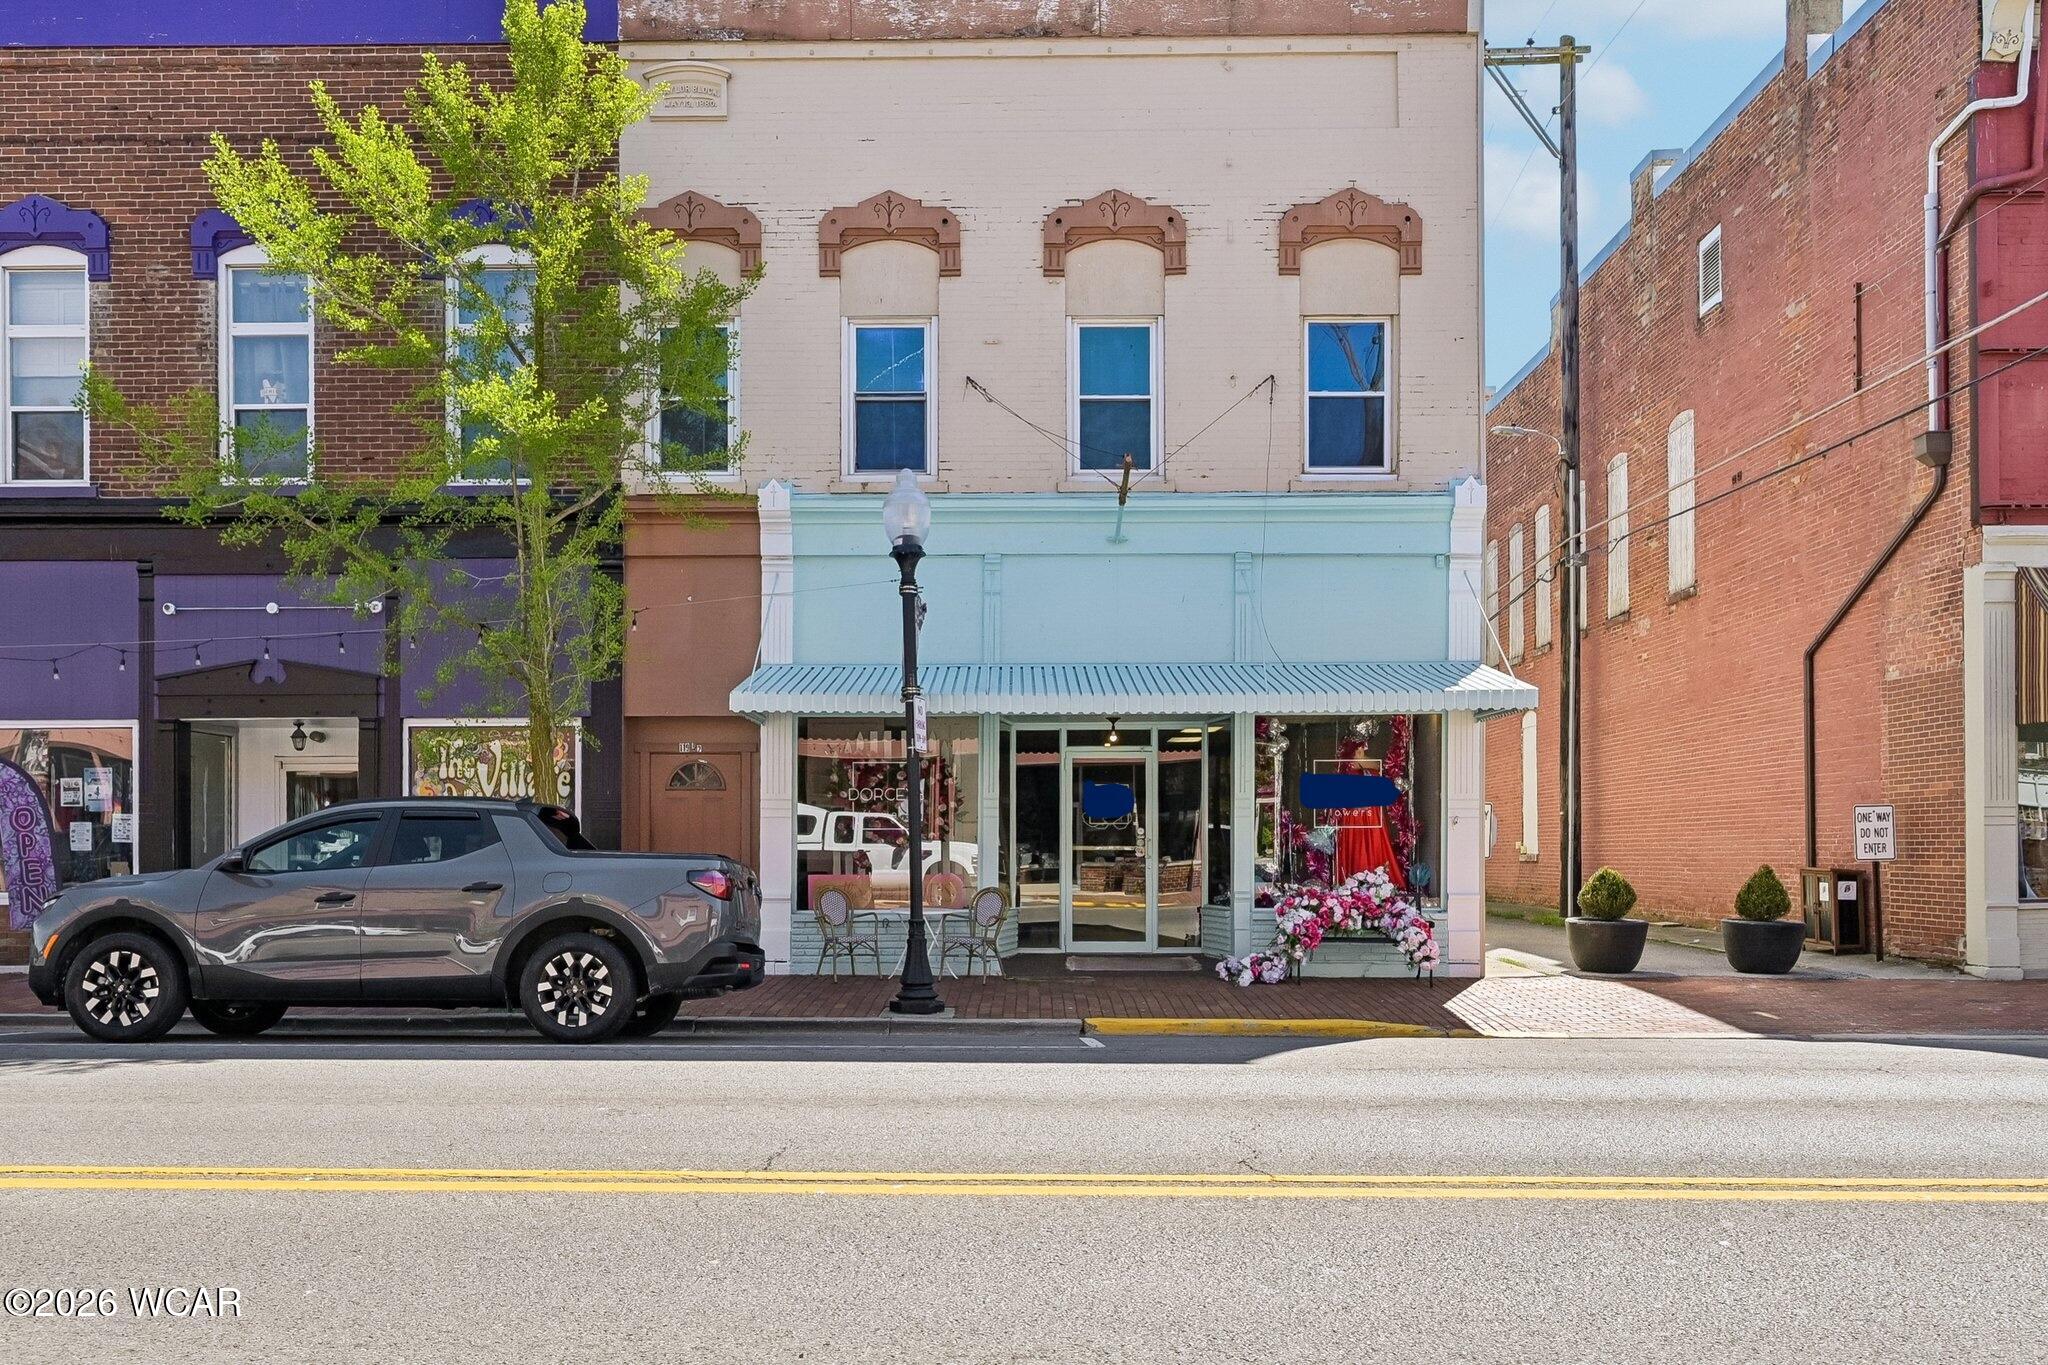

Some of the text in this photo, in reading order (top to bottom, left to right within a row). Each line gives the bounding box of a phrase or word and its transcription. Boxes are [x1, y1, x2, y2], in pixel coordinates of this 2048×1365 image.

[477, 739, 570, 797] Villae
[1857, 812, 1890, 823] ONE WAY
[1860, 827, 1888, 838] DO NOT
[1863, 843, 1887, 853] ENTER
[12, 806, 47, 913] OPEN
